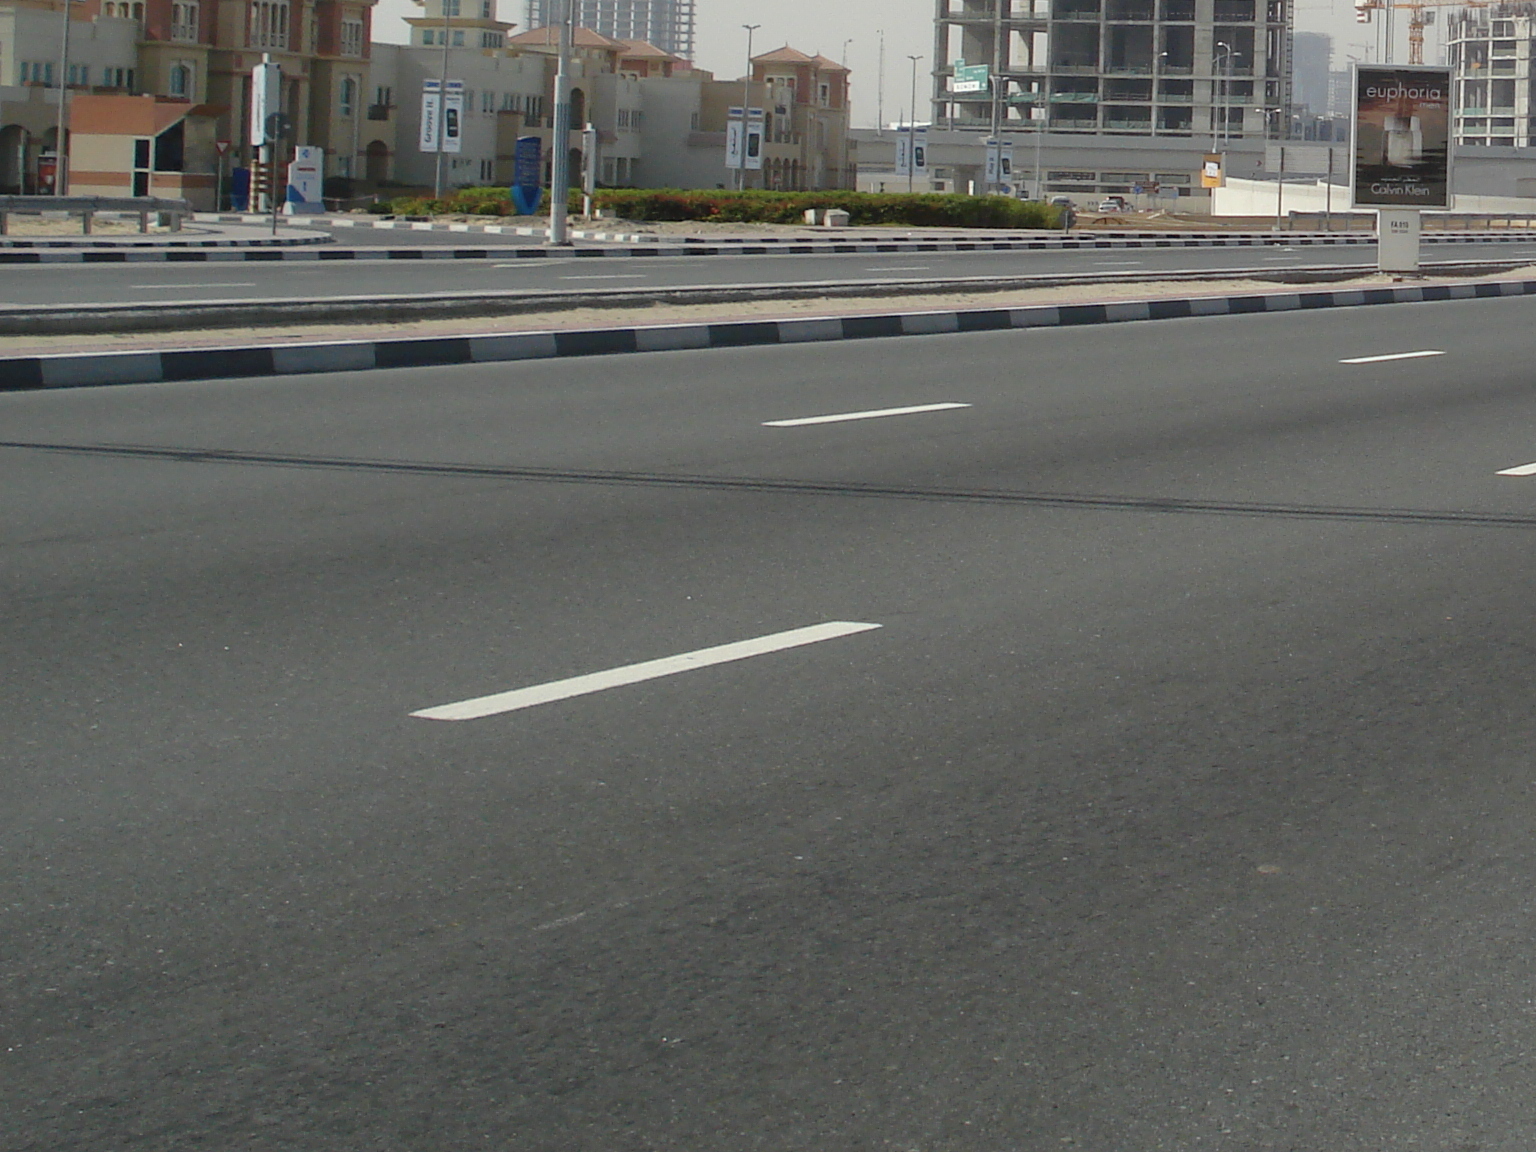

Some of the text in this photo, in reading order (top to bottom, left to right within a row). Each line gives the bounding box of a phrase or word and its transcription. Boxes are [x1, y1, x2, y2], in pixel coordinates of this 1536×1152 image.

[1366, 81, 1441, 102] euphoria
[1371, 183, 1430, 196] Calvin Klein
